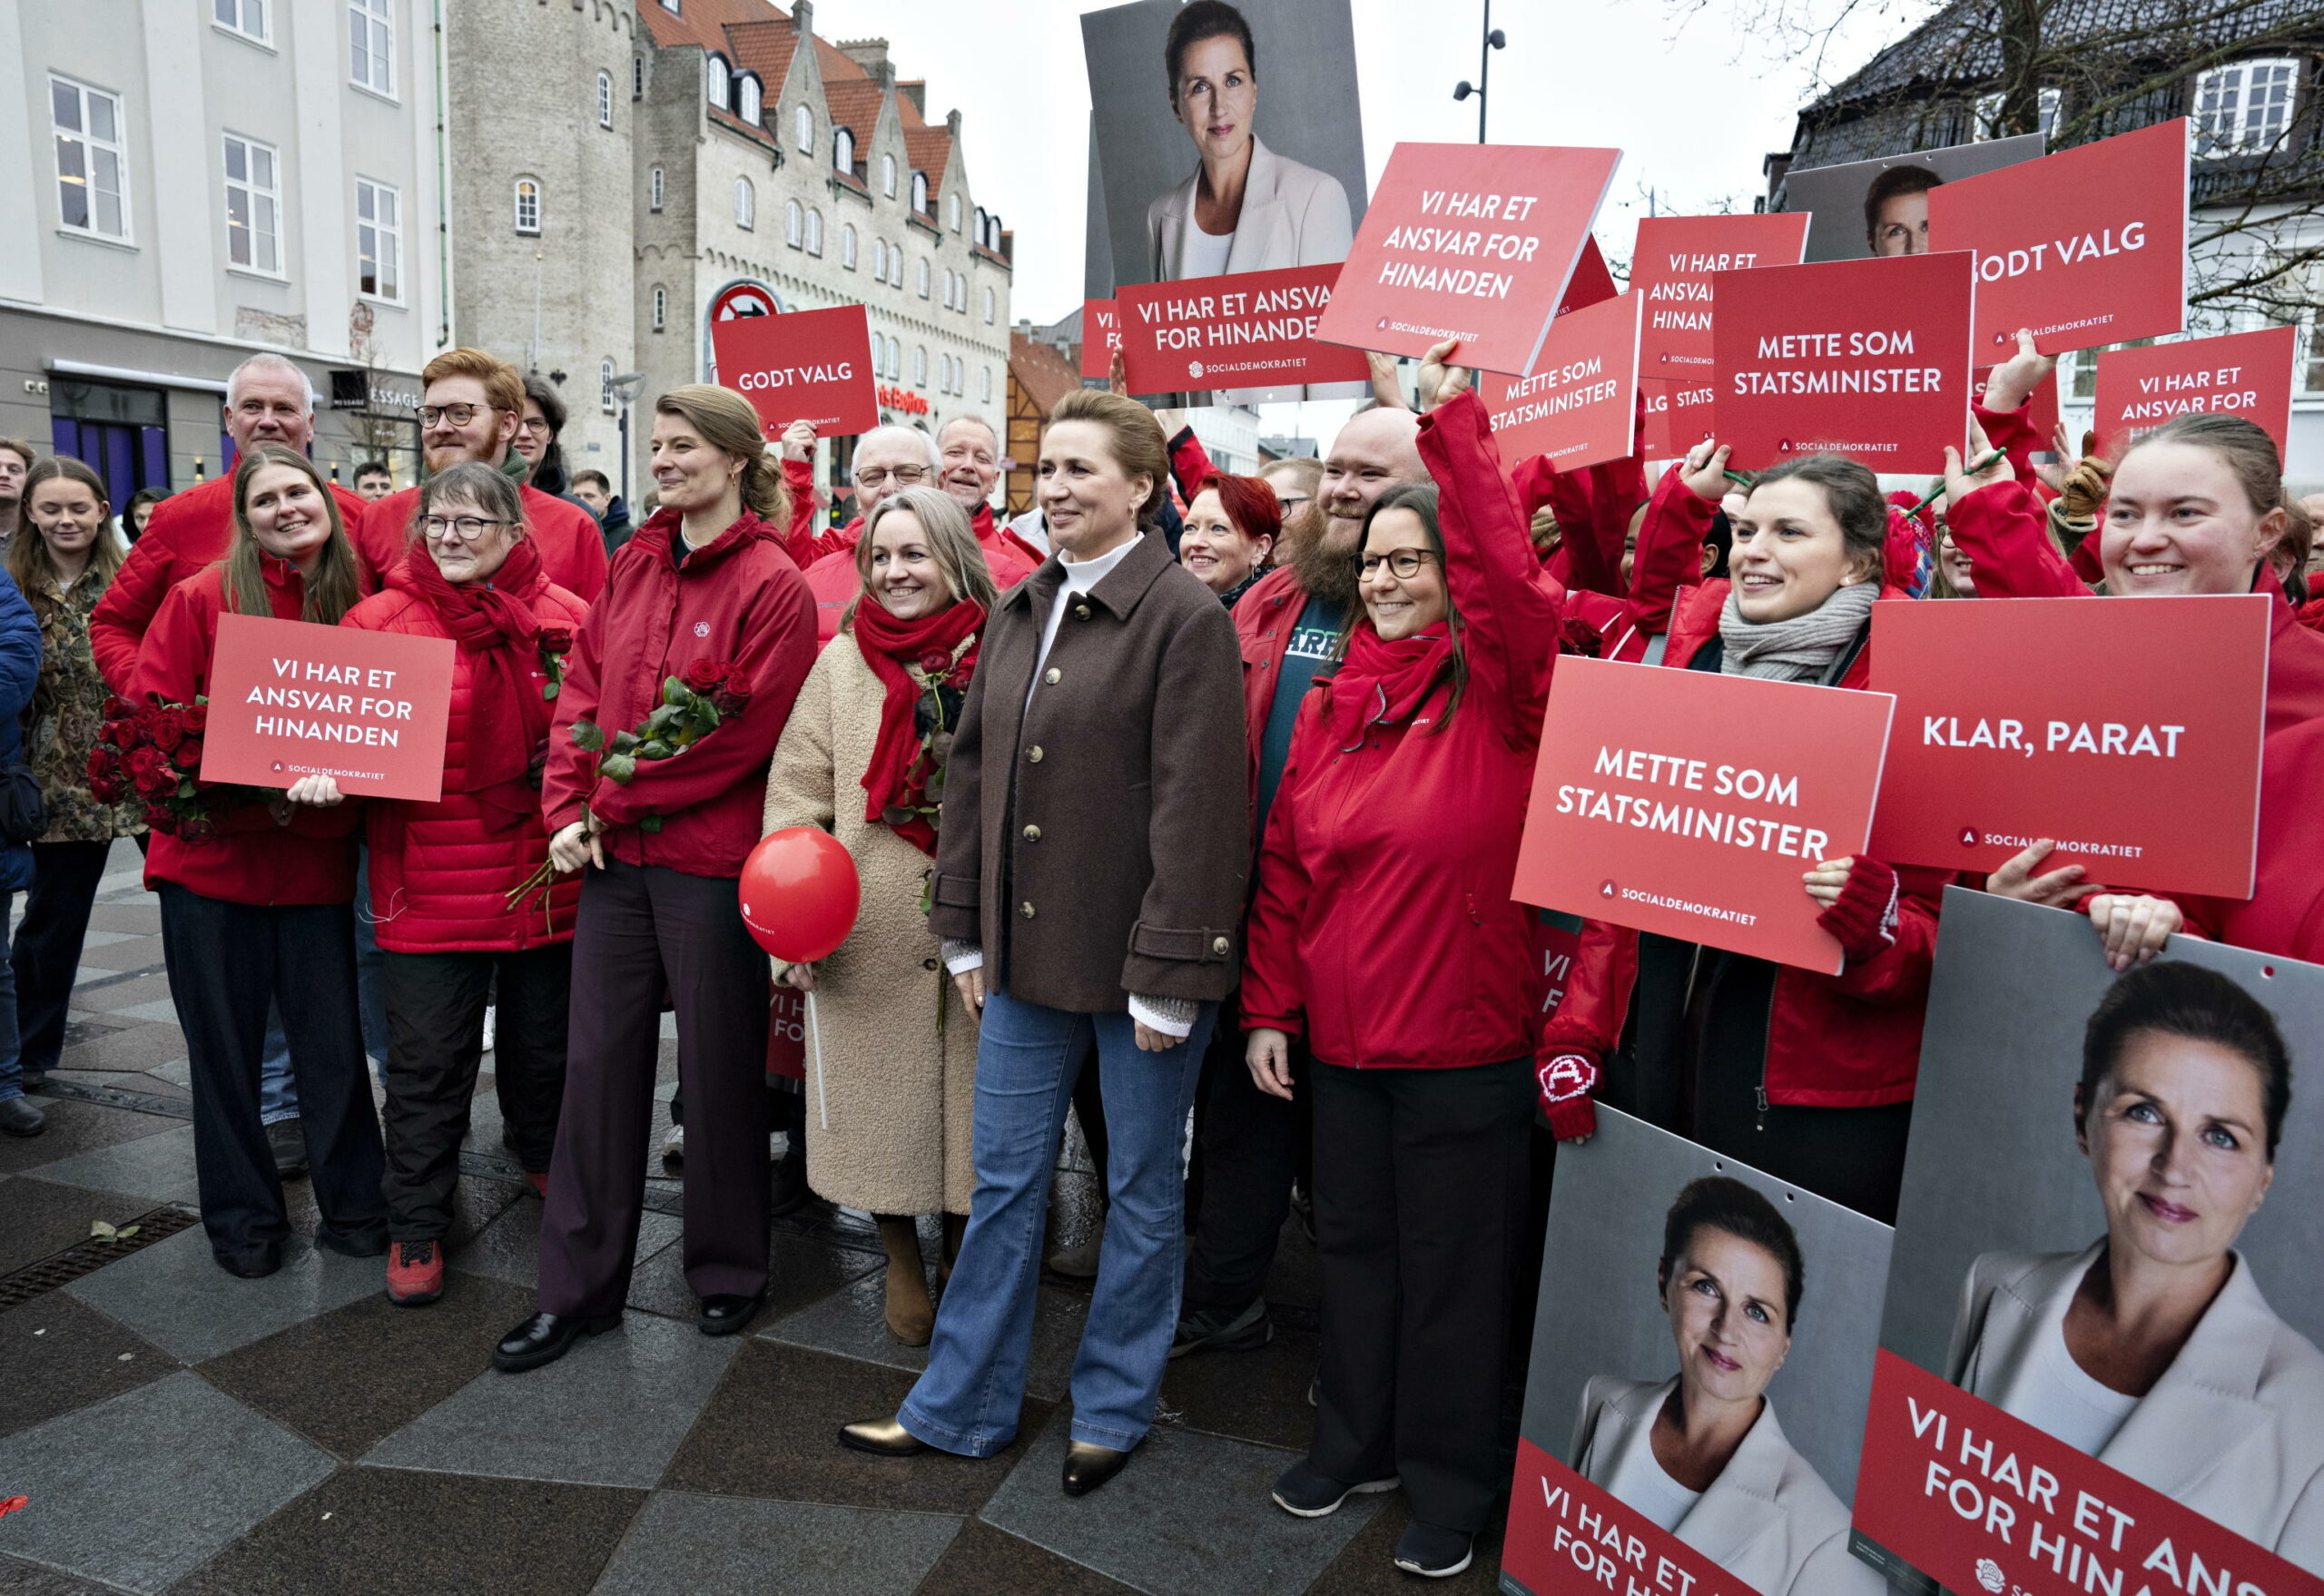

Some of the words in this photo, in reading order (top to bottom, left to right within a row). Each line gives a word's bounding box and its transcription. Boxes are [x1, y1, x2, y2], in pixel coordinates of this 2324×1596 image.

[1422, 191, 1445, 215] VI
[1445, 192, 1502, 219] HAR
[1502, 195, 1538, 222] ET
[1383, 225, 1482, 256] ANSVAR
[1482, 234, 1540, 261] FOR
[2054, 222, 2145, 265] VALG
[1669, 253, 1687, 272] VI
[1690, 253, 1729, 272] HAR
[1378, 261, 1513, 300] HINANDEN
[1097, 312, 1113, 328] VI
[1137, 300, 1161, 323] VI
[1167, 296, 1215, 321] HAR
[1222, 292, 1247, 317] ET
[1155, 327, 1202, 351] FOR
[1208, 315, 1322, 347] HINANDE
[1390, 321, 1480, 343] SOCIALDEMOKRATIET
[1758, 333, 1842, 359] METTE
[1849, 330, 1915, 356] SOM
[739, 368, 795, 390] GODT
[799, 362, 852, 385] VALG
[1206, 358, 1307, 373] SOCIALDEMOKRATIET
[1505, 369, 1559, 401] METTE
[1561, 356, 1601, 384] SOM
[1734, 368, 1942, 395] STATSMINISTER
[2140, 378, 2160, 394] VI
[2166, 370, 2211, 392] HAR
[2216, 367, 2241, 386] ET
[1490, 379, 1617, 432] STATSMINISTER
[1645, 396, 1668, 413] LG
[2121, 397, 2204, 420] ANSVAR
[2211, 390, 2257, 411] FOR
[1795, 442, 1898, 452] SOCIALDEMOKRATIET
[272, 657, 298, 679] VI
[306, 662, 360, 685] HAR
[368, 669, 397, 689] ET
[246, 685, 353, 714] ANSVAR
[360, 697, 412, 720] FOR
[255, 715, 399, 748] HINANDEN
[1923, 715, 2034, 758] KLAR,
[2046, 721, 2185, 757] PARAT
[288, 764, 386, 780] SOCIALDEMOKRATIET
[1594, 745, 1707, 791] METTE
[1713, 764, 1798, 807] SOM
[1556, 784, 1828, 861] STATSMINISTER
[1984, 833, 2142, 858] SOCIALMOKRATIET
[1621, 888, 1757, 926] SOCIALDEMOKRATIET
[1545, 950, 1571, 980] VI
[1907, 1396, 1947, 1452] VI
[1960, 1428, 2060, 1515] HAR
[2073, 1490, 2134, 1552] ET
[2142, 1537, 2268, 1596] AN
[1541, 1475, 1570, 1519] VI
[1579, 1502, 1647, 1571] HAR
[1656, 1555, 1697, 1596] ET
[1925, 1460, 2016, 1544] FOR
[2030, 1521, 2152, 1596] HIN
[1553, 1524, 1617, 1591] FOR
